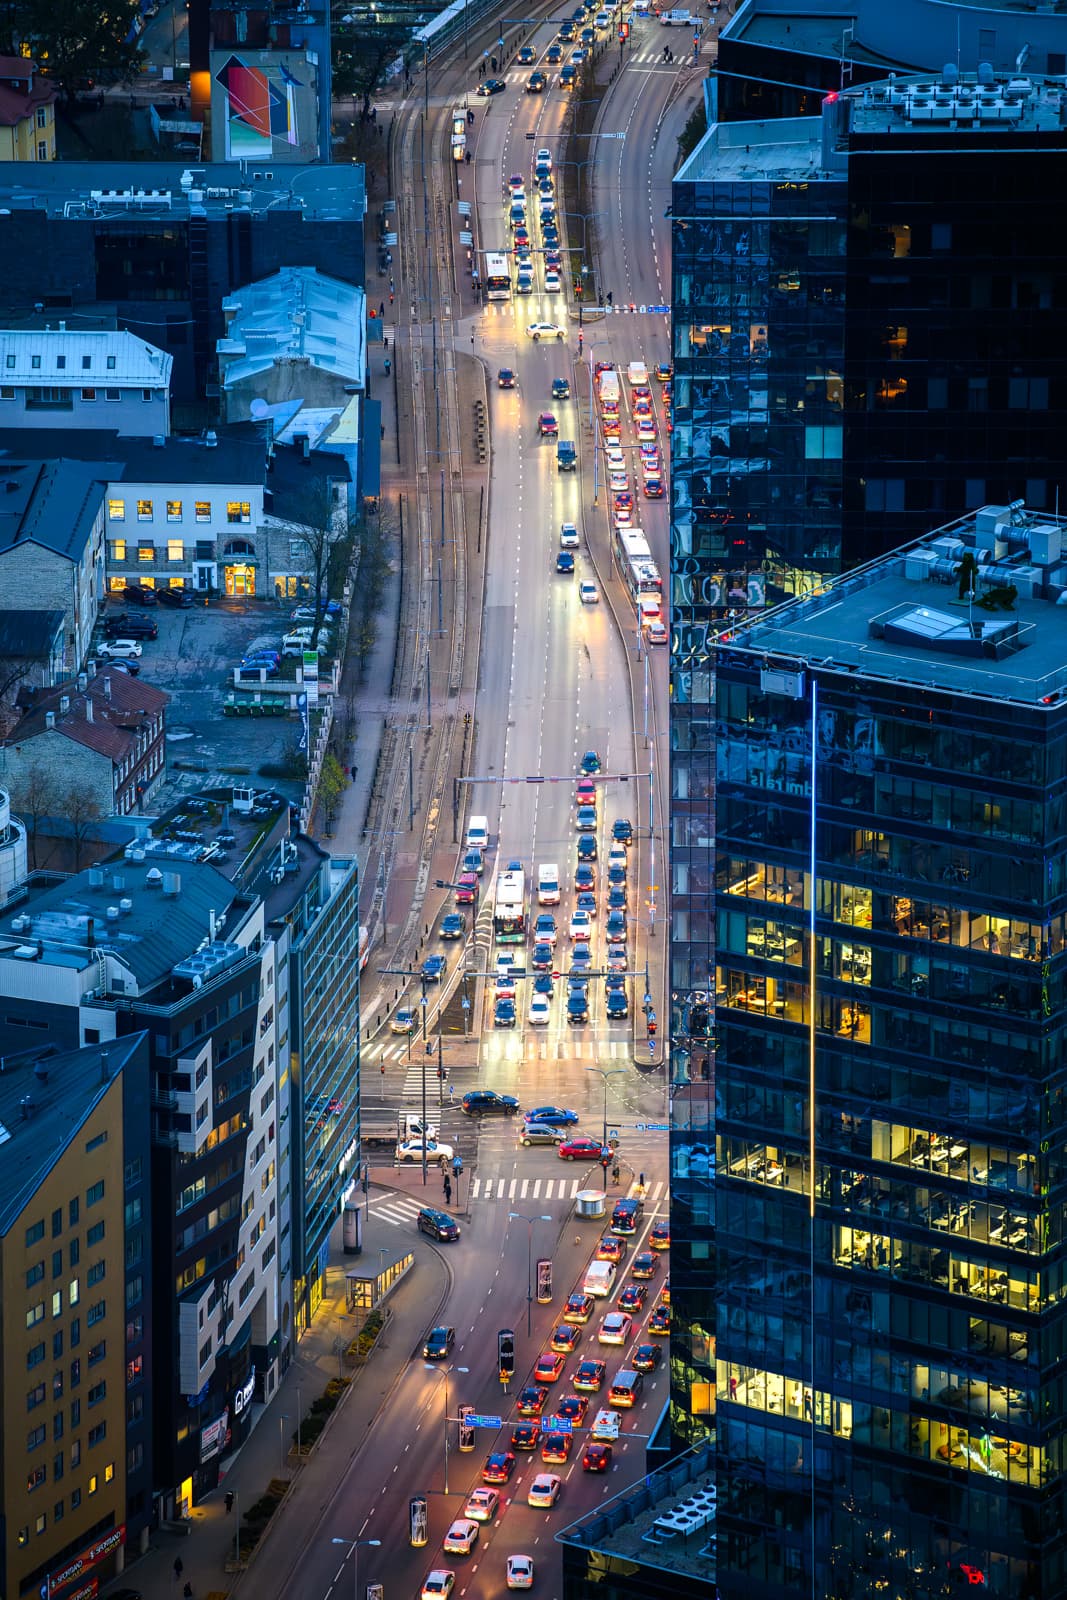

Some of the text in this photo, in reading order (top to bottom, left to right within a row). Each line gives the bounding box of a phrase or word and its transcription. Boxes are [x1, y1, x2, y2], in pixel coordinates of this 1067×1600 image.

[95, 1531, 121, 1555] SPORTLAND
[104, 1539, 121, 1554] OUTLET
[57, 1560, 83, 1584] SPORTLAND
